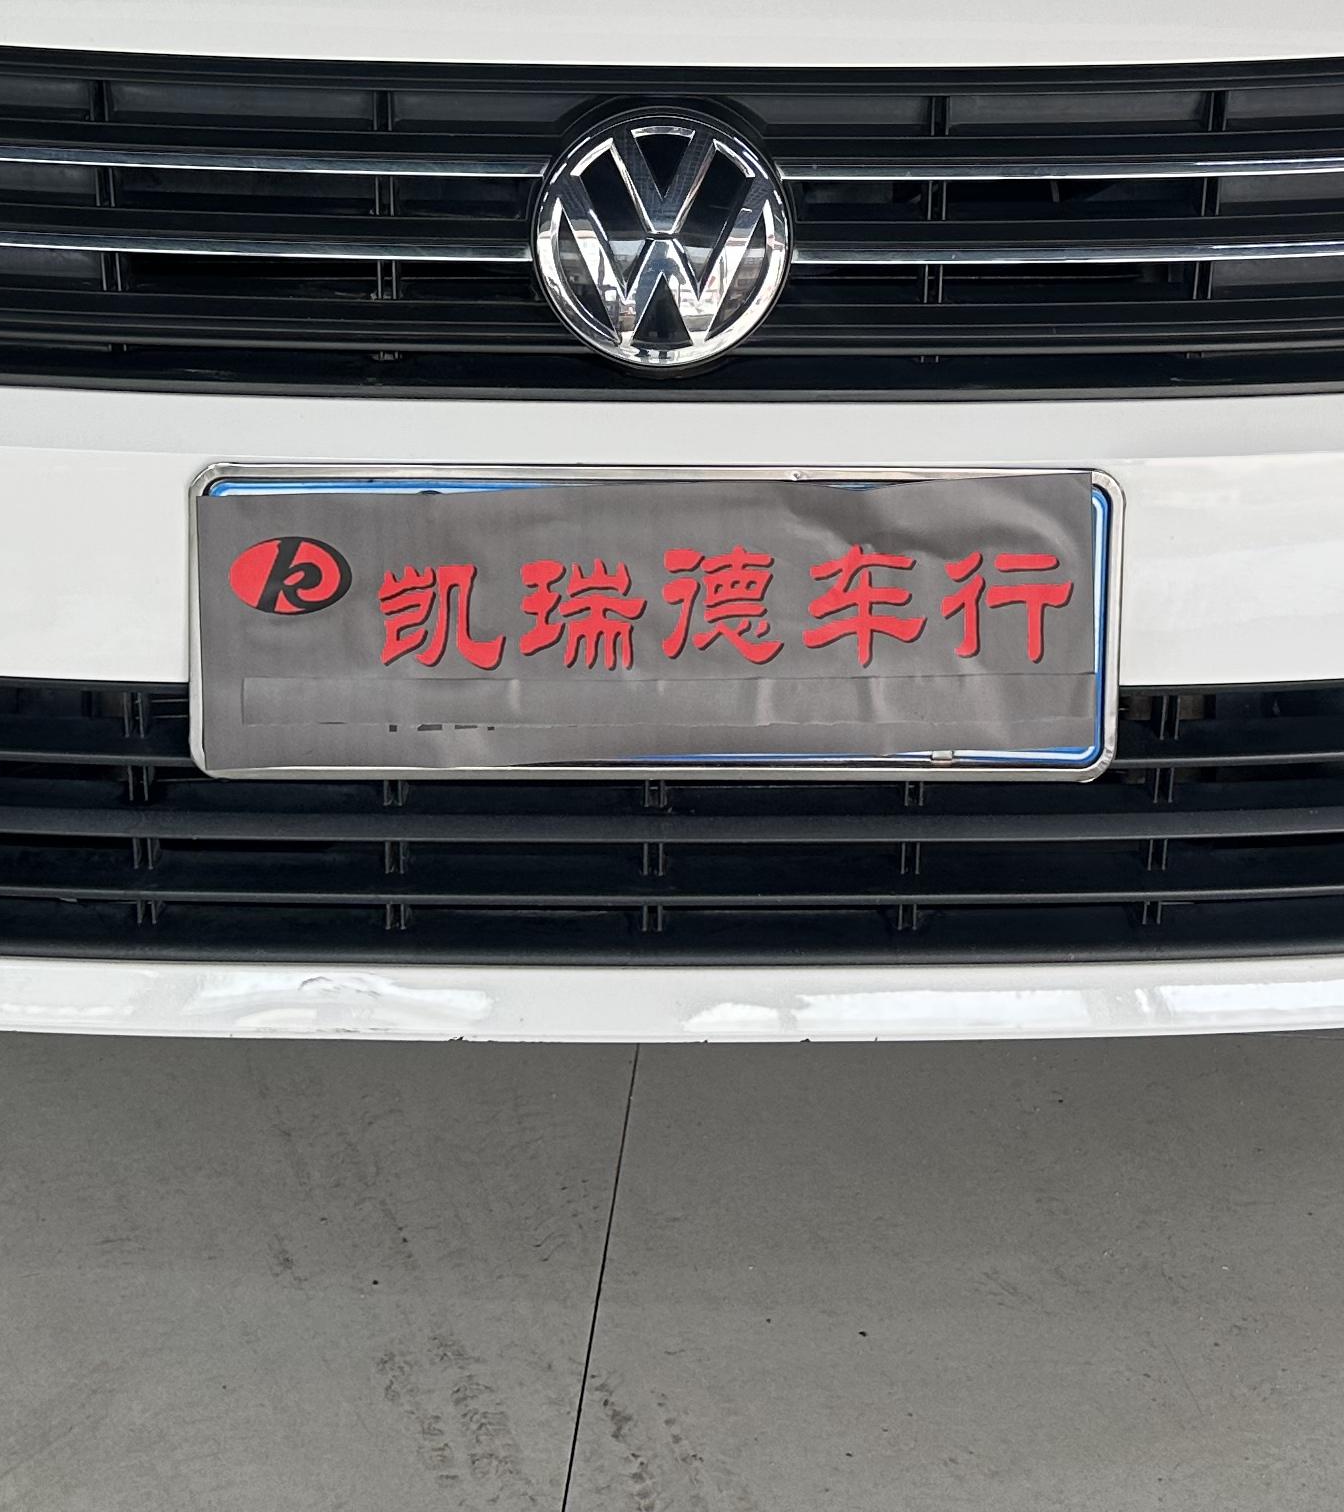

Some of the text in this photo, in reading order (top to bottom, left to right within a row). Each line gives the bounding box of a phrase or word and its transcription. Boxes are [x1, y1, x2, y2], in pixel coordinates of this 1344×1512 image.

[378, 545, 1072, 670] 凯瑞德车行
